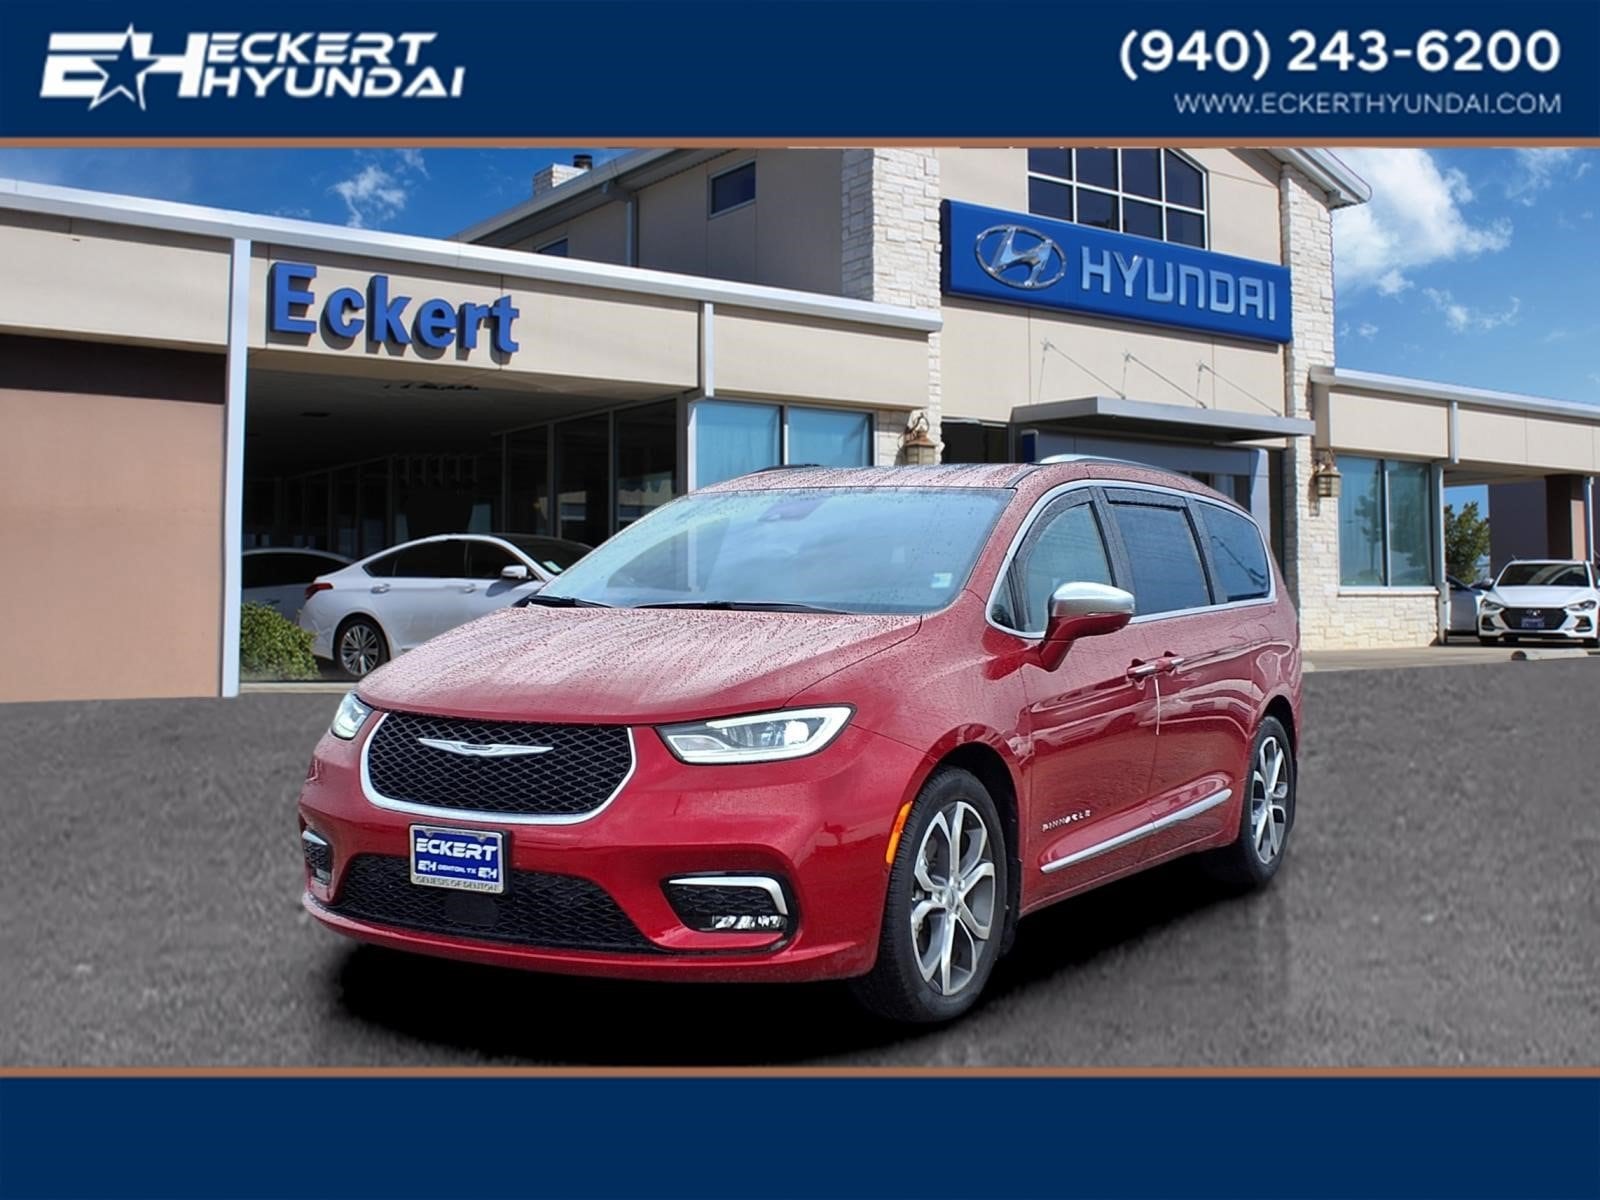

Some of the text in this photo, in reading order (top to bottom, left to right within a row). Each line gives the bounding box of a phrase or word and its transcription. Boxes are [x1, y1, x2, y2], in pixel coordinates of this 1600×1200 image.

[267, 261, 520, 354] Eckert
[1081, 245, 1277, 321] HYUNDAI
[415, 838, 498, 861] ECKERT
